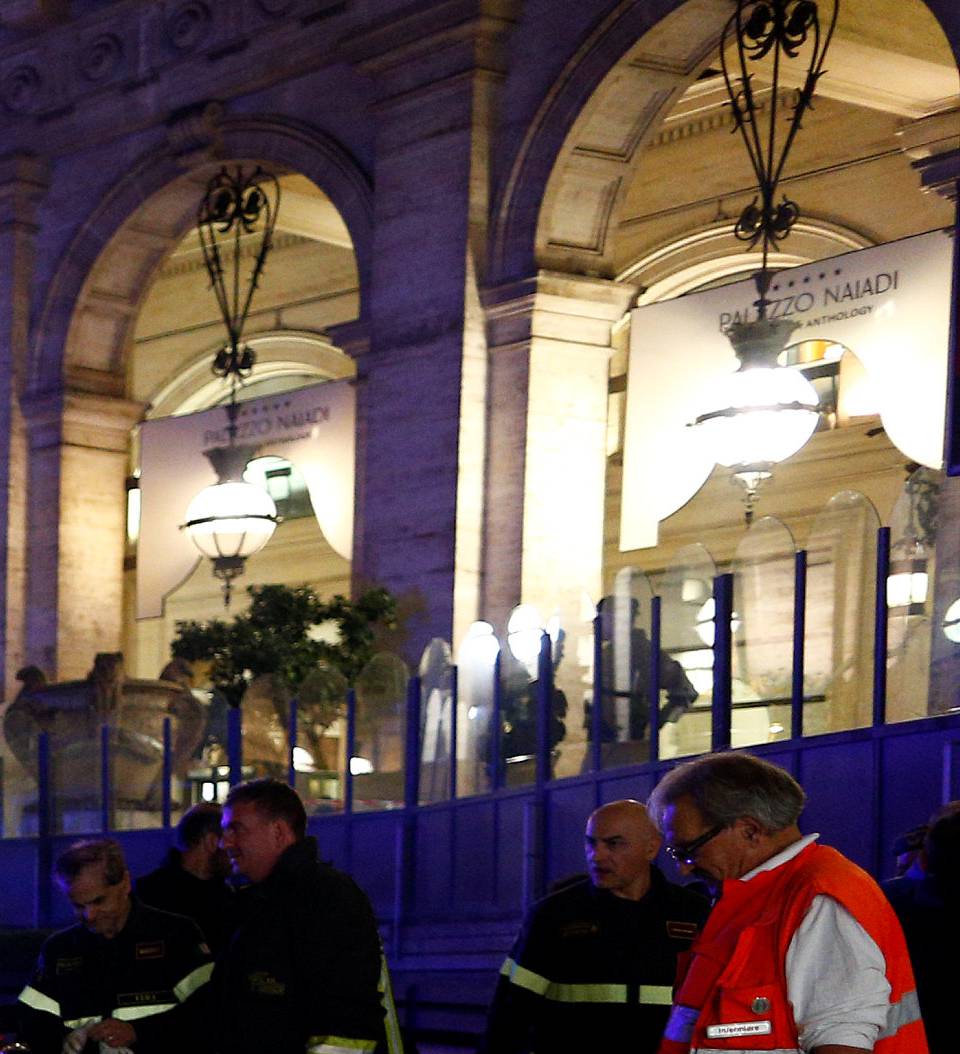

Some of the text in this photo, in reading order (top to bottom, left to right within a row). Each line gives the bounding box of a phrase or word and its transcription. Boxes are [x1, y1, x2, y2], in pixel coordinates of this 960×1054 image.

[720, 292, 814, 332] PALZZO
[824, 270, 899, 308] NAIADI
[805, 304, 874, 328] ANTHOLOGY
